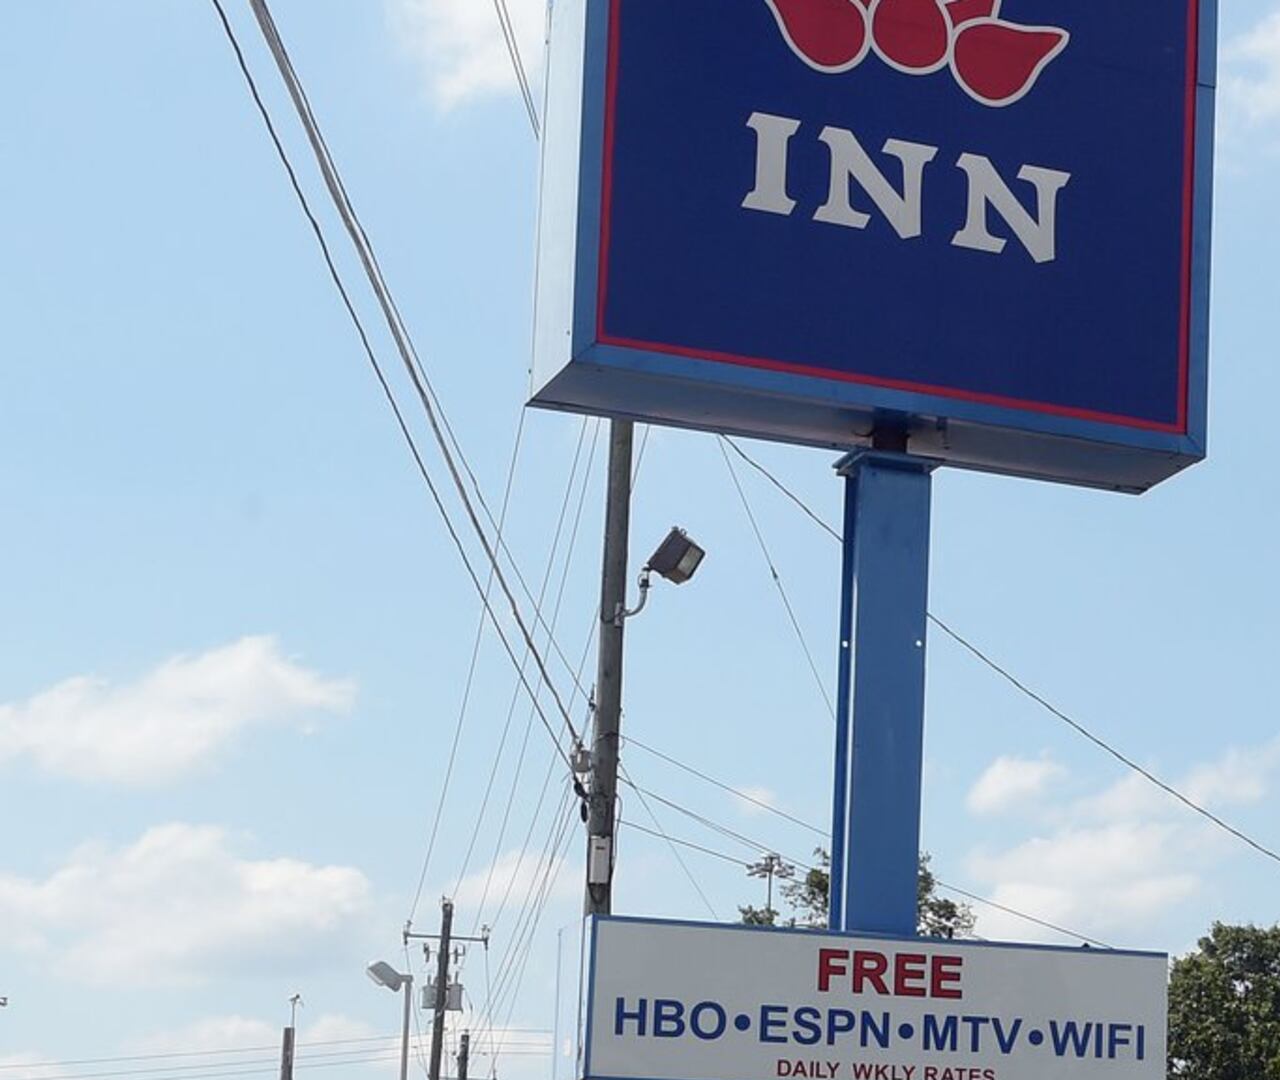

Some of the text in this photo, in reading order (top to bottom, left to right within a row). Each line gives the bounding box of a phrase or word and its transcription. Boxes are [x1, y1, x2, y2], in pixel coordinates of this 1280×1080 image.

[741, 111, 1071, 264] INN
[817, 948, 963, 999] FREE
[776, 1059, 839, 1080] DAILY
